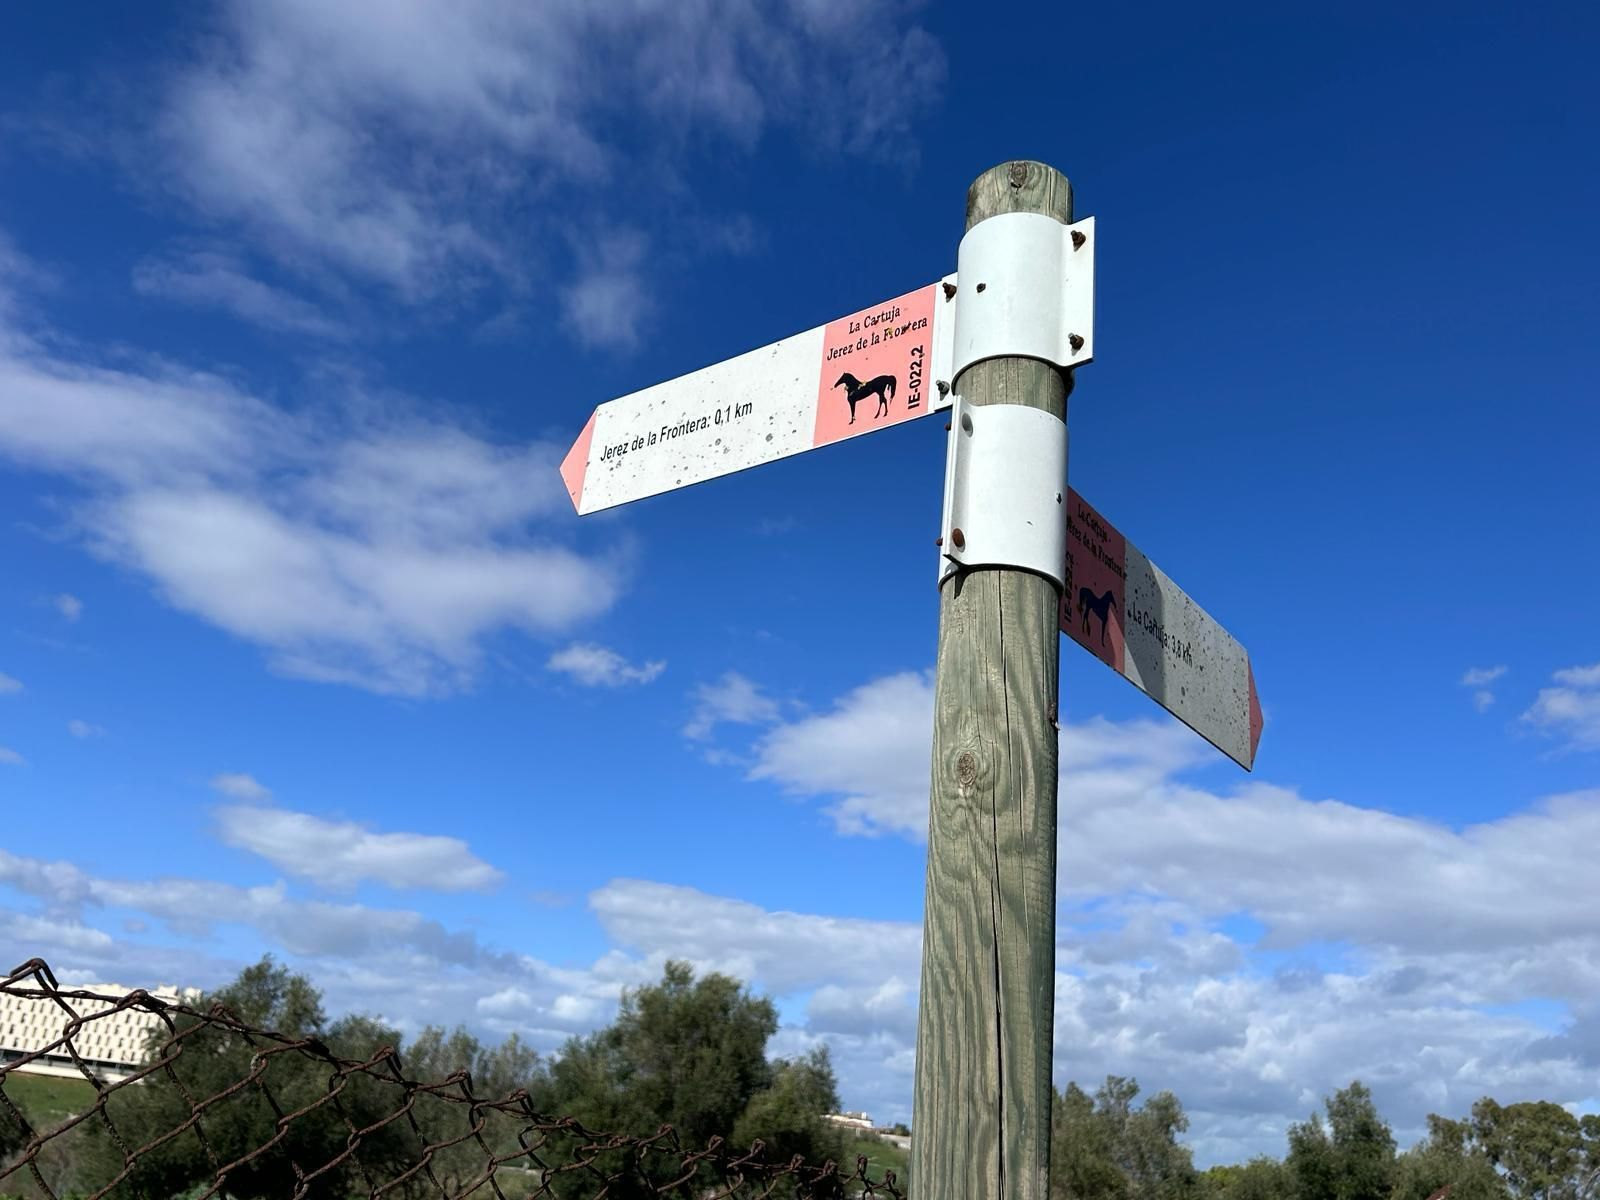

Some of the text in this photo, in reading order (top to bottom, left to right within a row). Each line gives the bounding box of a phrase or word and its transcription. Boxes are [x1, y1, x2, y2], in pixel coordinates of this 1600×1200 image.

[827, 318, 927, 361] Jerez de la Frontera
[848, 306, 900, 335] La Cartuja
[907, 344, 924, 410] IE-022.2
[600, 402, 753, 461] Jerez de la Frontera: 0,1 km
[1132, 601, 1142, 625] La
